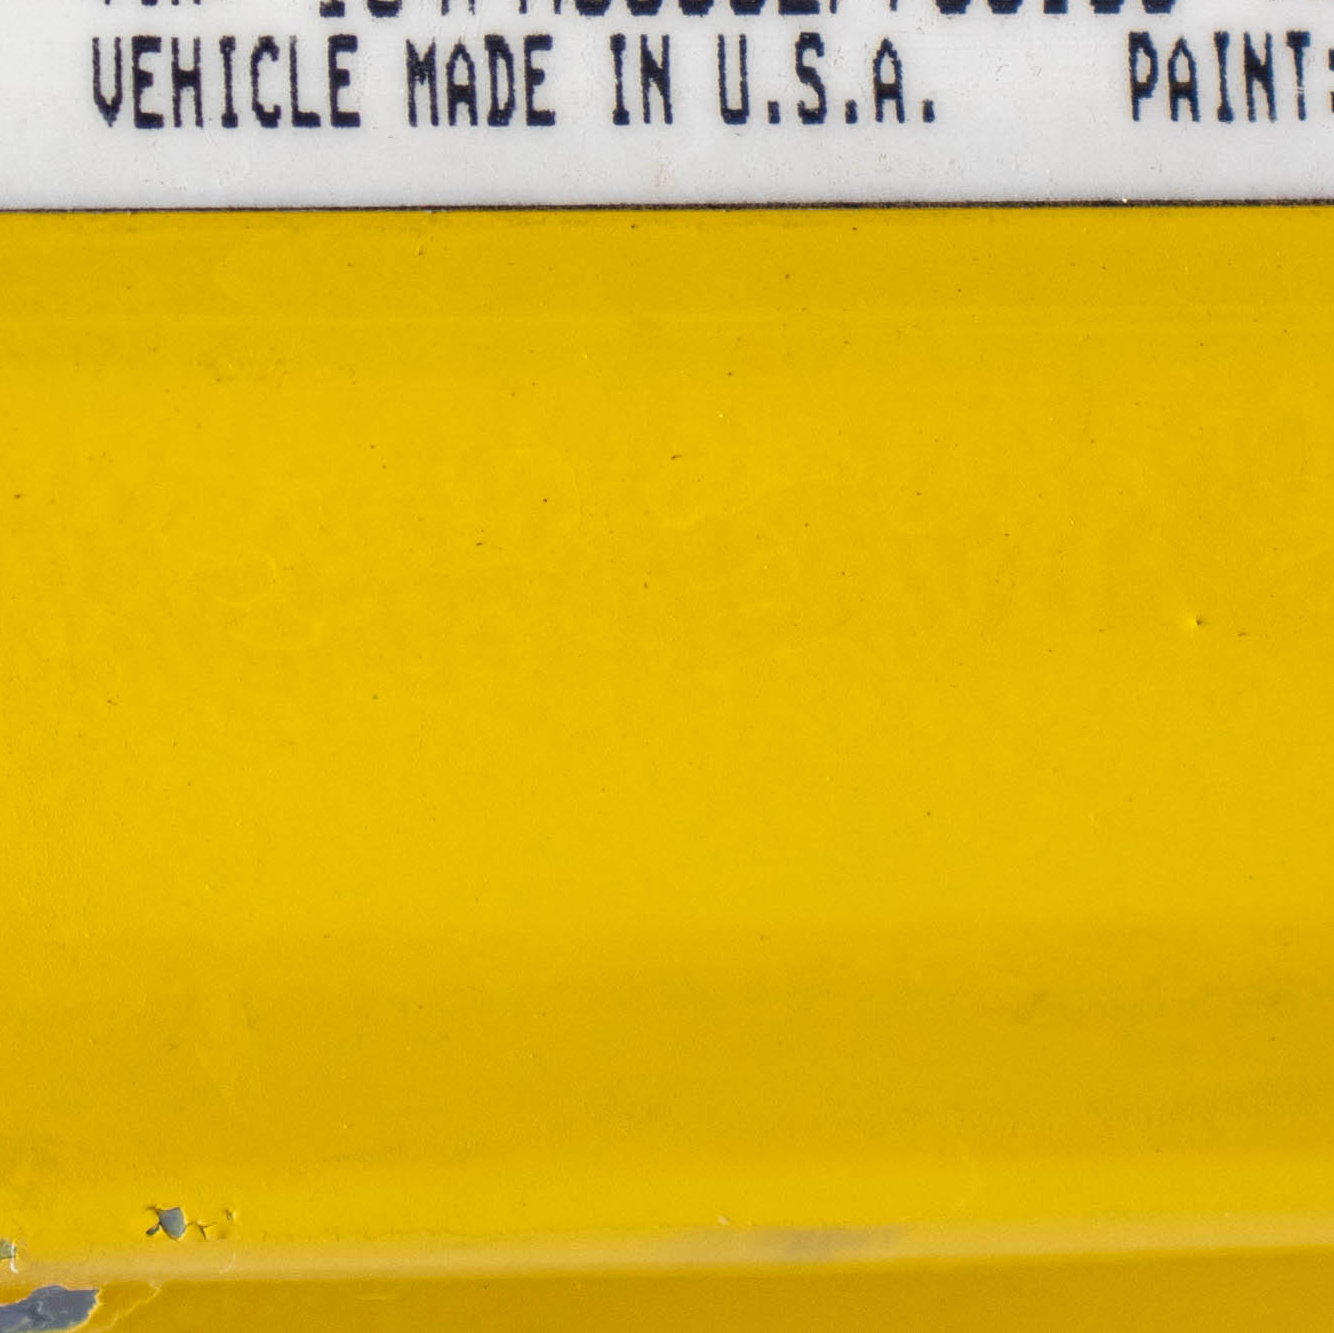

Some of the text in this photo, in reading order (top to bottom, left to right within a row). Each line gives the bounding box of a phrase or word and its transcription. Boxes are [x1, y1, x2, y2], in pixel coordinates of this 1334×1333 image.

[92, 33, 361, 130] VEHICLE
[405, 33, 556, 128] MADE
[609, 32, 674, 126] IN
[717, 31, 936, 126] U.S.A.
